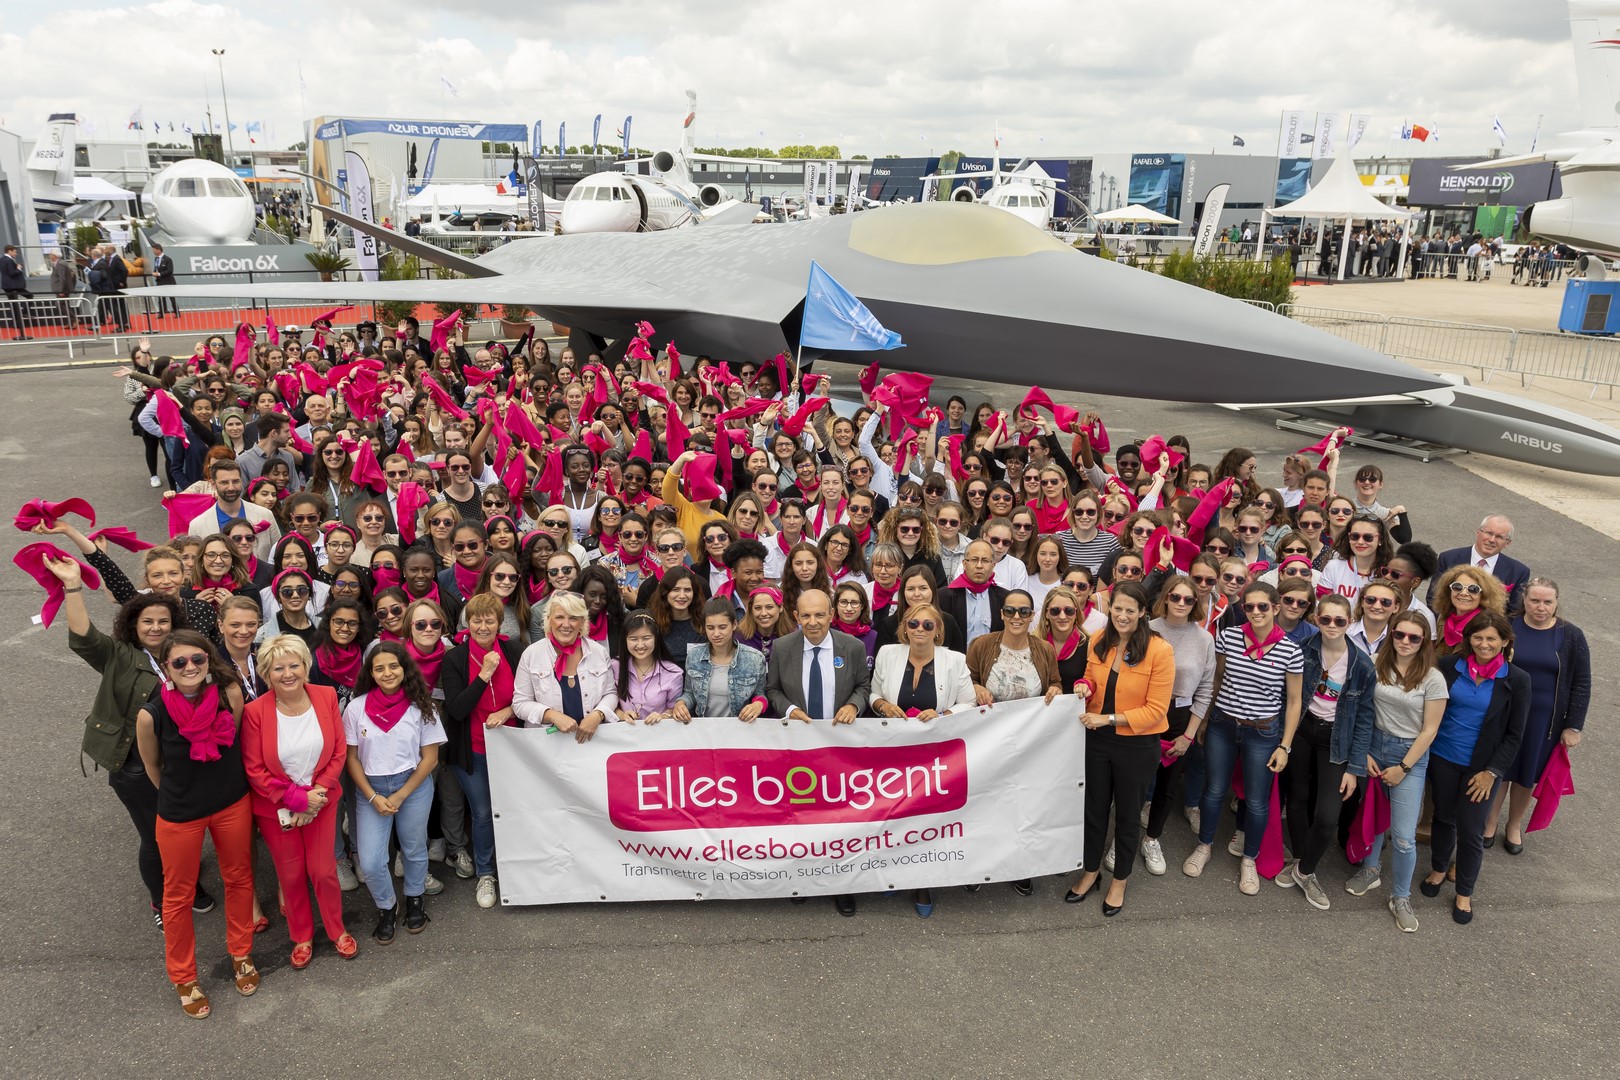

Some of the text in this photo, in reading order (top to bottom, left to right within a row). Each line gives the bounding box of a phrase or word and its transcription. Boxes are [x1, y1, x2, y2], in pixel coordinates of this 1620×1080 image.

[388, 124, 468, 136] AZUR DRONES
[1286, 116, 1298, 156] HENSOLDT
[1320, 118, 1332, 156] HENSOLDT
[1186, 176, 1194, 203] RAFAEL
[1440, 176, 1510, 188] HENSOLDT
[356, 185, 375, 256] Faln 6X
[1197, 200, 1219, 256] Falcon 2000
[190, 255, 280, 272] Falcon 6X
[1500, 431, 1562, 454] AIRBUS
[636, 756, 949, 810] Elles bougent
[618, 821, 964, 862] www.ellesbougent.com
[622, 849, 964, 883] Transmettre la passion, susciter des vocations
